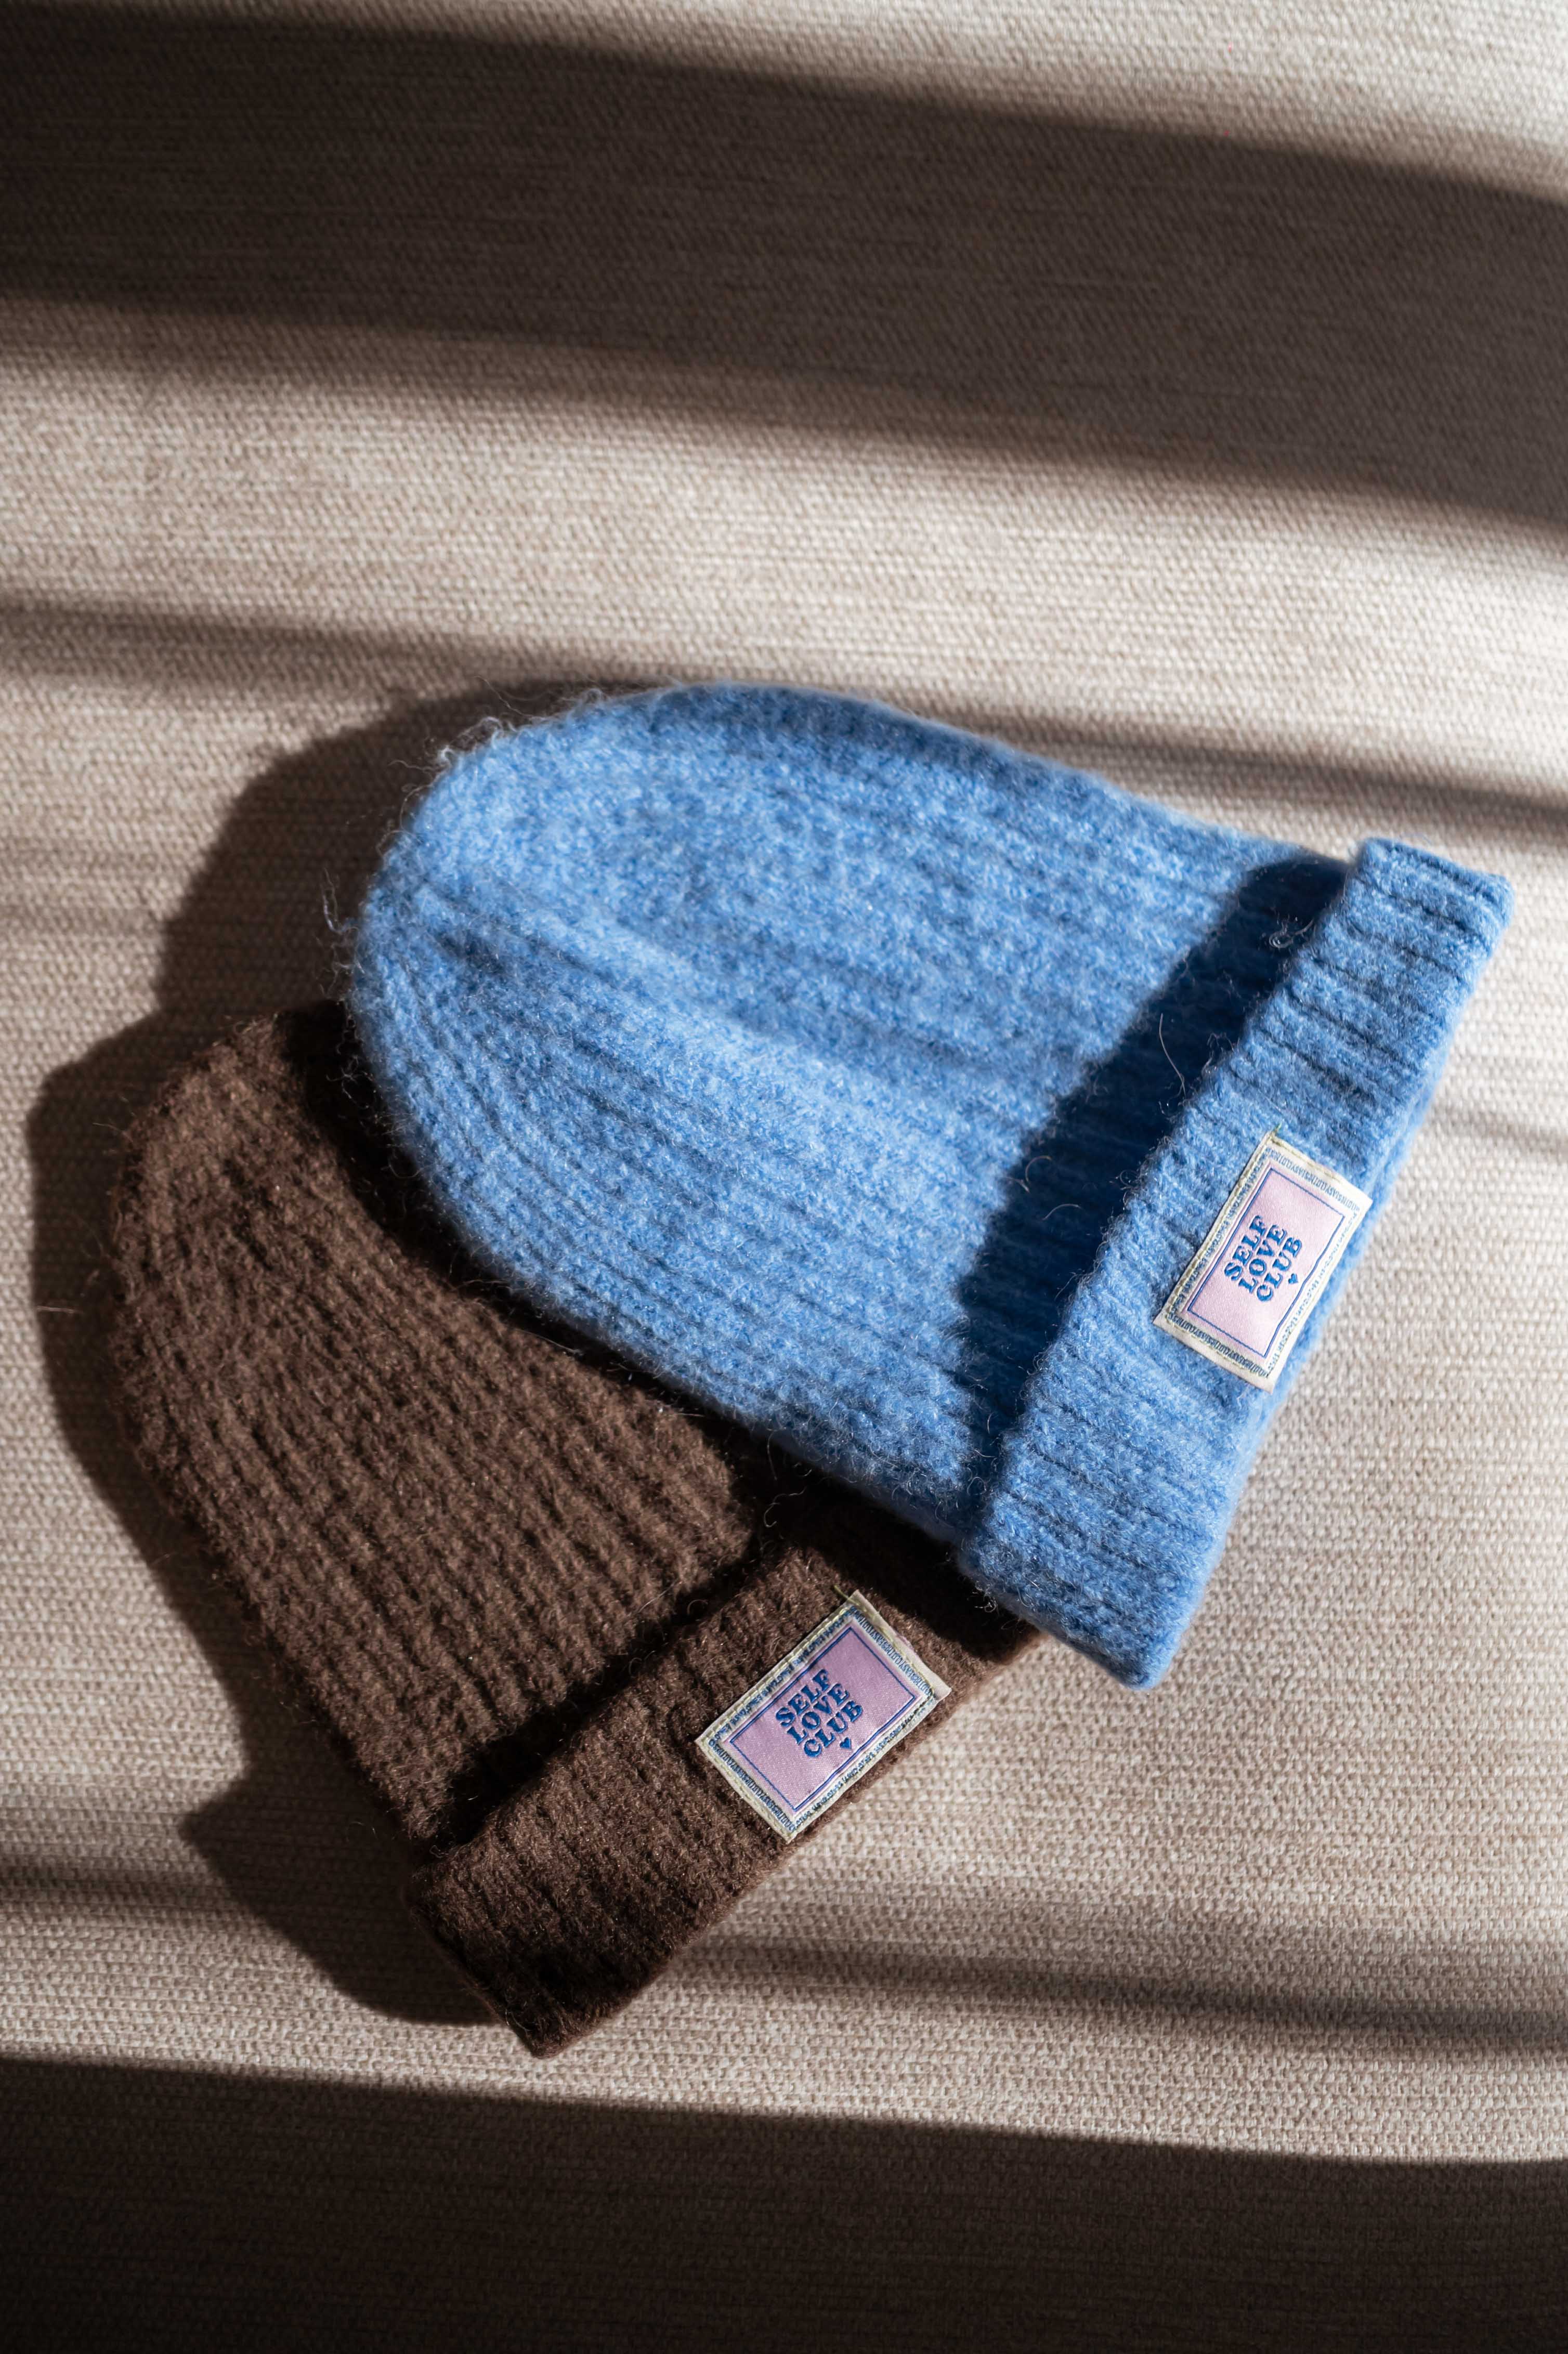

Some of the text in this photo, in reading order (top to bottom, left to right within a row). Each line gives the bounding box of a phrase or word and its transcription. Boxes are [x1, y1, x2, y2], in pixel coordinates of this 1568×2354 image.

[1224, 1215, 1266, 1281] SELF
[1238, 1224, 1287, 1294] LOVE
[1257, 1237, 1302, 1301] CLUB
[776, 1669, 830, 1727] SELF
[787, 1683, 850, 1745] LOVE
[804, 1701, 864, 1758] CLUB
